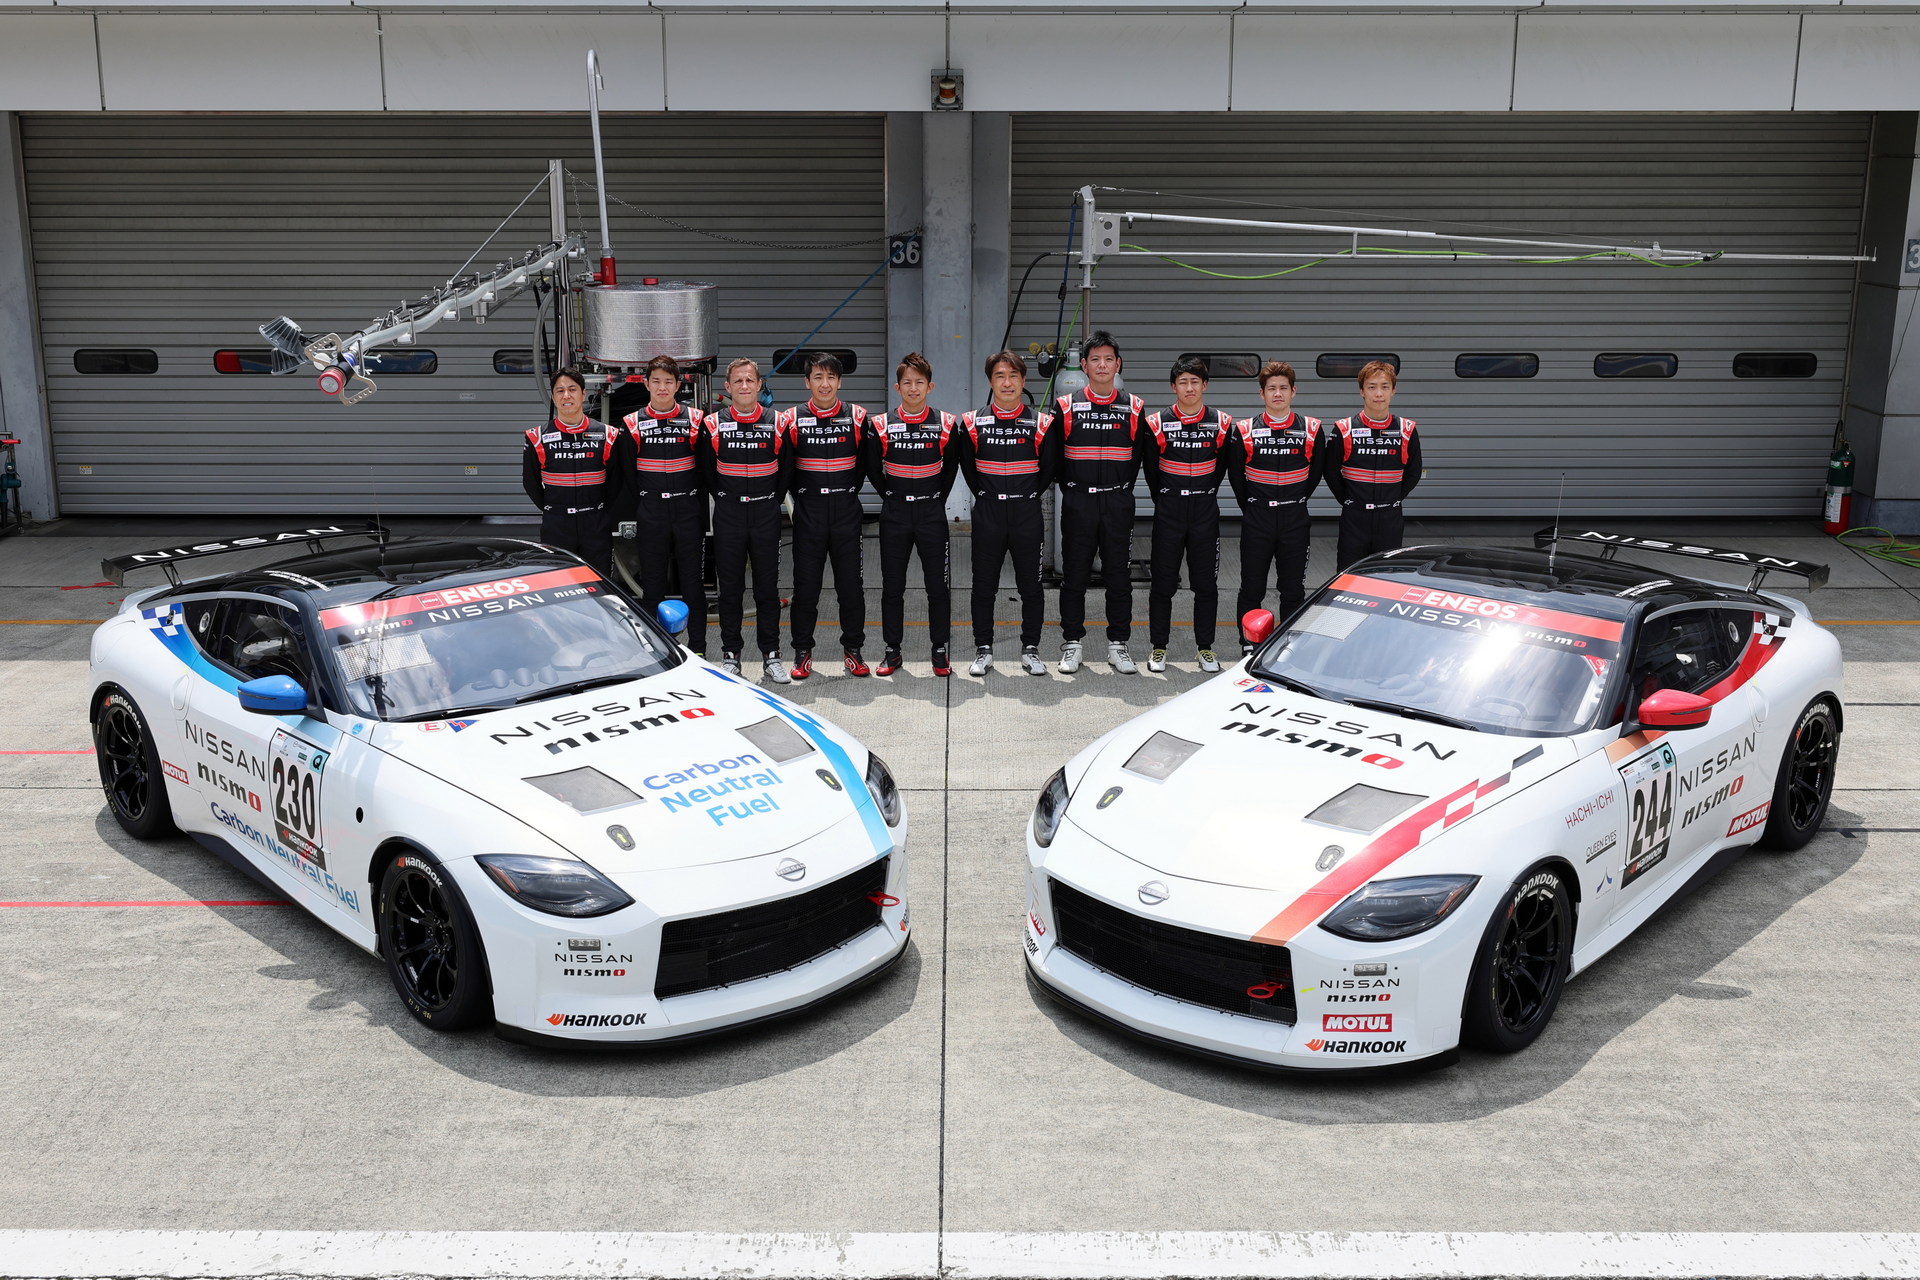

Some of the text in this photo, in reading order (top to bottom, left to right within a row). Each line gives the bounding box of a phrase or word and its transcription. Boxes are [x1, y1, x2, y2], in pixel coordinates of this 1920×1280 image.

[891, 240, 920, 264] 36
[1078, 412, 1125, 420] NISSAN
[640, 426, 690, 437] NISSAN
[722, 431, 771, 439] NISSAN
[802, 426, 850, 434] NISSAN
[890, 432, 938, 440] NISSAN
[982, 427, 1031, 436] NISSAN
[1254, 438, 1304, 446] NISSAN
[1352, 438, 1402, 446] NISSAN
[549, 441, 599, 450] NISSAN
[131, 526, 344, 562] NISSAN
[1580, 531, 1799, 567] NISSAN
[440, 578, 530, 605] ENEOS
[428, 593, 545, 623] NISSAN
[1422, 591, 1518, 620] ENEOS
[489, 688, 706, 746] NISSAN
[1229, 702, 1457, 761] NISSAN
[185, 719, 266, 782] NISSAN
[312, 754, 323, 770] Q
[1663, 749, 1672, 764] Q
[163, 762, 187, 782] MOTUL
[643, 754, 762, 790] Carbon
[1680, 732, 1756, 797] NISSAN
[272, 756, 316, 840] 230
[660, 768, 784, 814] Neutral
[706, 792, 780, 827] Fuel
[1564, 790, 1614, 830] HACHI-ICHI
[1630, 771, 1672, 860] 244
[1730, 804, 1769, 834] MOTUL
[210, 802, 360, 913] Carbon Neutral Fuel
[1586, 830, 1616, 858] QUEEN EYES
[554, 953, 633, 963] NISSAN
[1320, 978, 1400, 988] NISSAN
[1326, 1016, 1389, 1030] MOTUL
